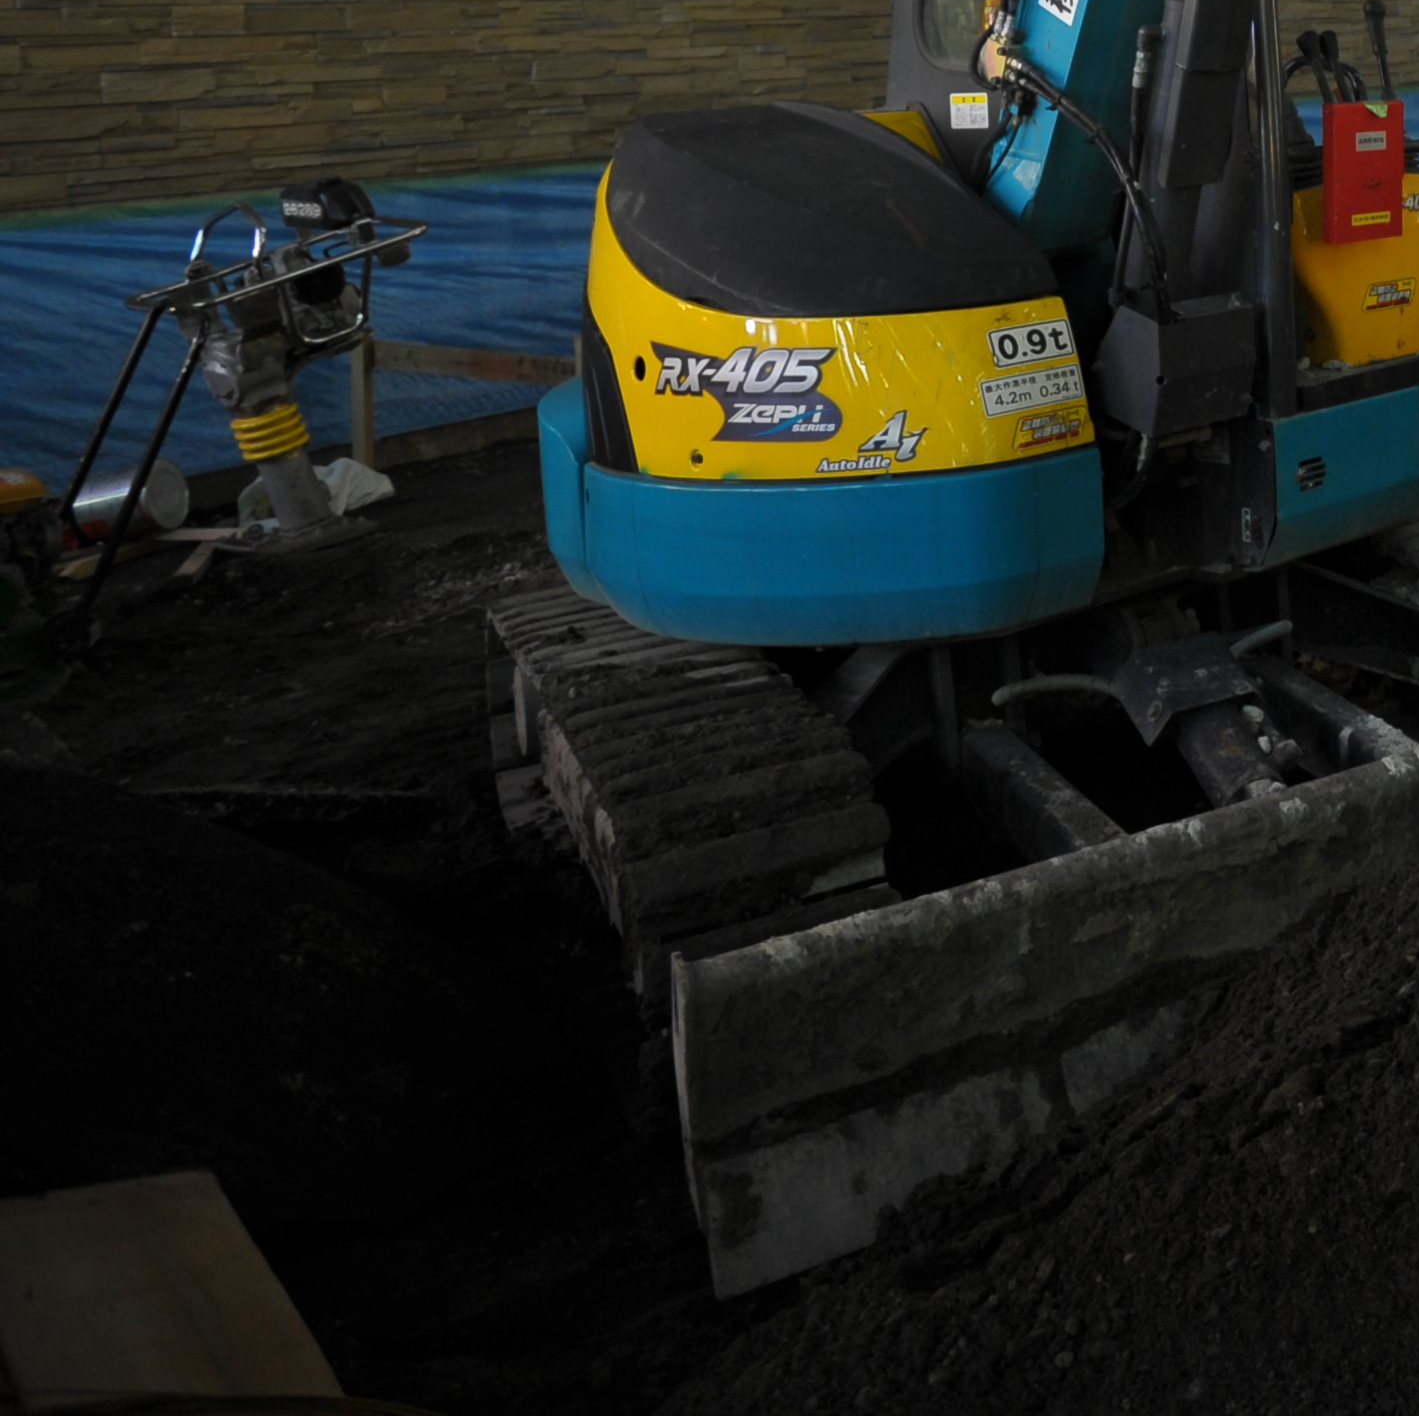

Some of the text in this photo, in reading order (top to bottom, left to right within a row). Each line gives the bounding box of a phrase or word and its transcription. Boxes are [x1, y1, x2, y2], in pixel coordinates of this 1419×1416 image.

[998, 327, 1068, 360] 0.9t
[657, 347, 832, 394] RX-405
[985, 368, 1076, 394] 最大作業半径 定格荷重
[994, 391, 1032, 407] 4.2m
[1039, 381, 1070, 398] 0.34
[791, 423, 836, 432] SERIES
[859, 410, 928, 461] Ai
[817, 456, 891, 473] AutoIdle
